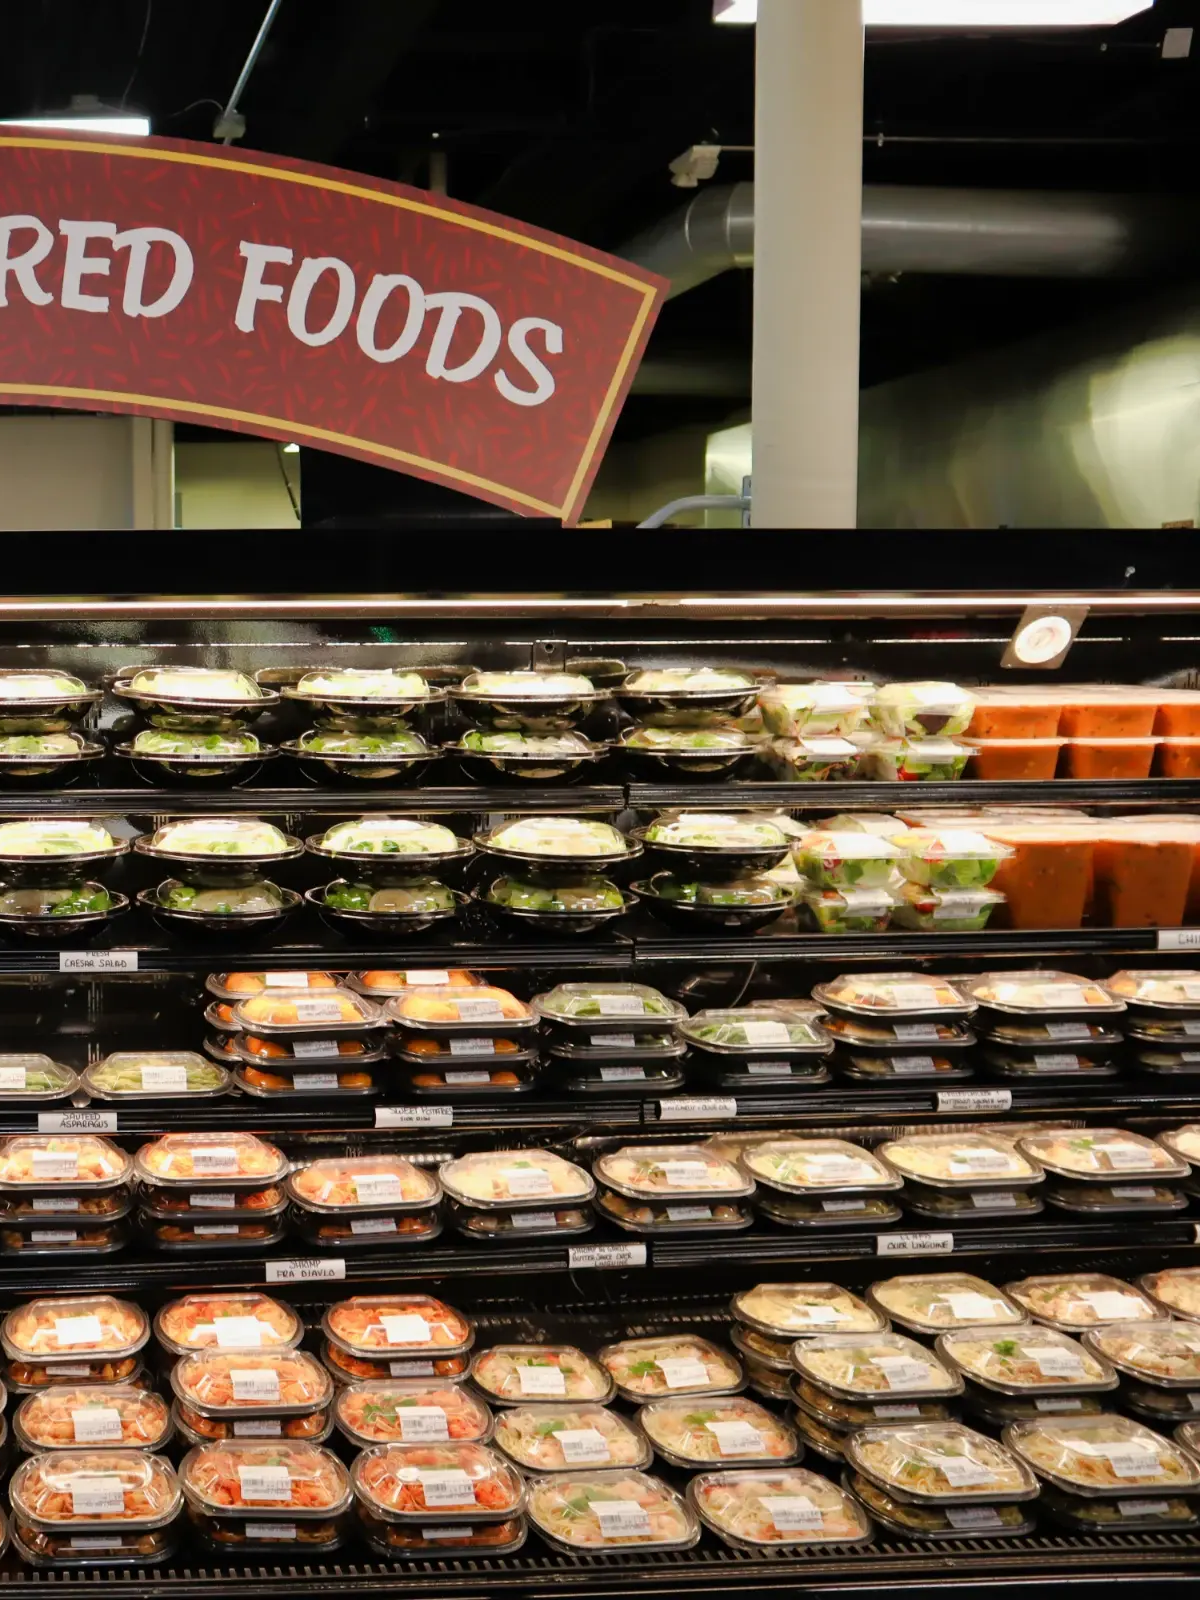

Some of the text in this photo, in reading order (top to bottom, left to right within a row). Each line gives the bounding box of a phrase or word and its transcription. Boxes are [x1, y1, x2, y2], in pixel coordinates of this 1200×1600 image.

[235, 240, 564, 407] FOODS
[64, 959, 127, 968] CAESAR SALAD
[59, 1120, 108, 1129] ASPARAGUS
[276, 1270, 295, 1278] FRA
